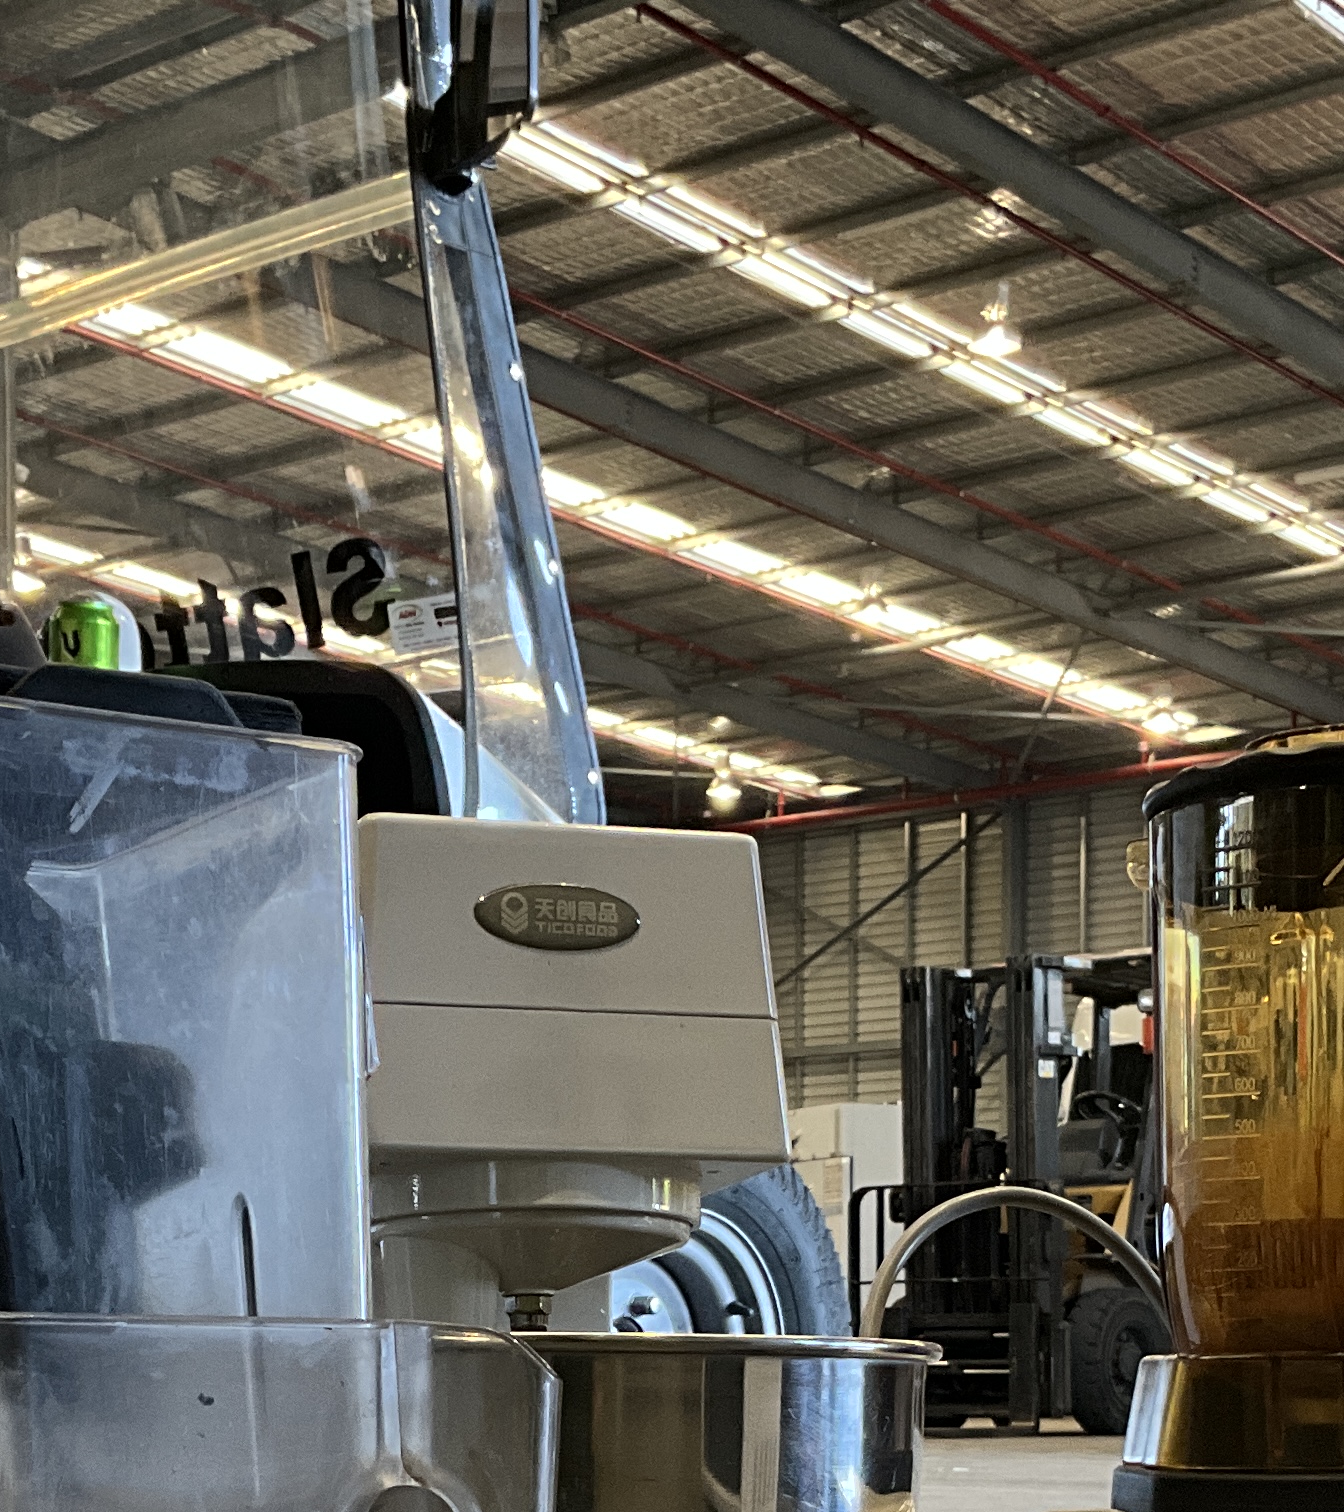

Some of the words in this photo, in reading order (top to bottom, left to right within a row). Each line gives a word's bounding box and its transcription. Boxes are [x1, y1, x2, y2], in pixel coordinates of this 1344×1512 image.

[534, 898, 619, 923] 天创食品
[1234, 1078, 1256, 1091] 600
[1234, 1119, 1256, 1133] 500
